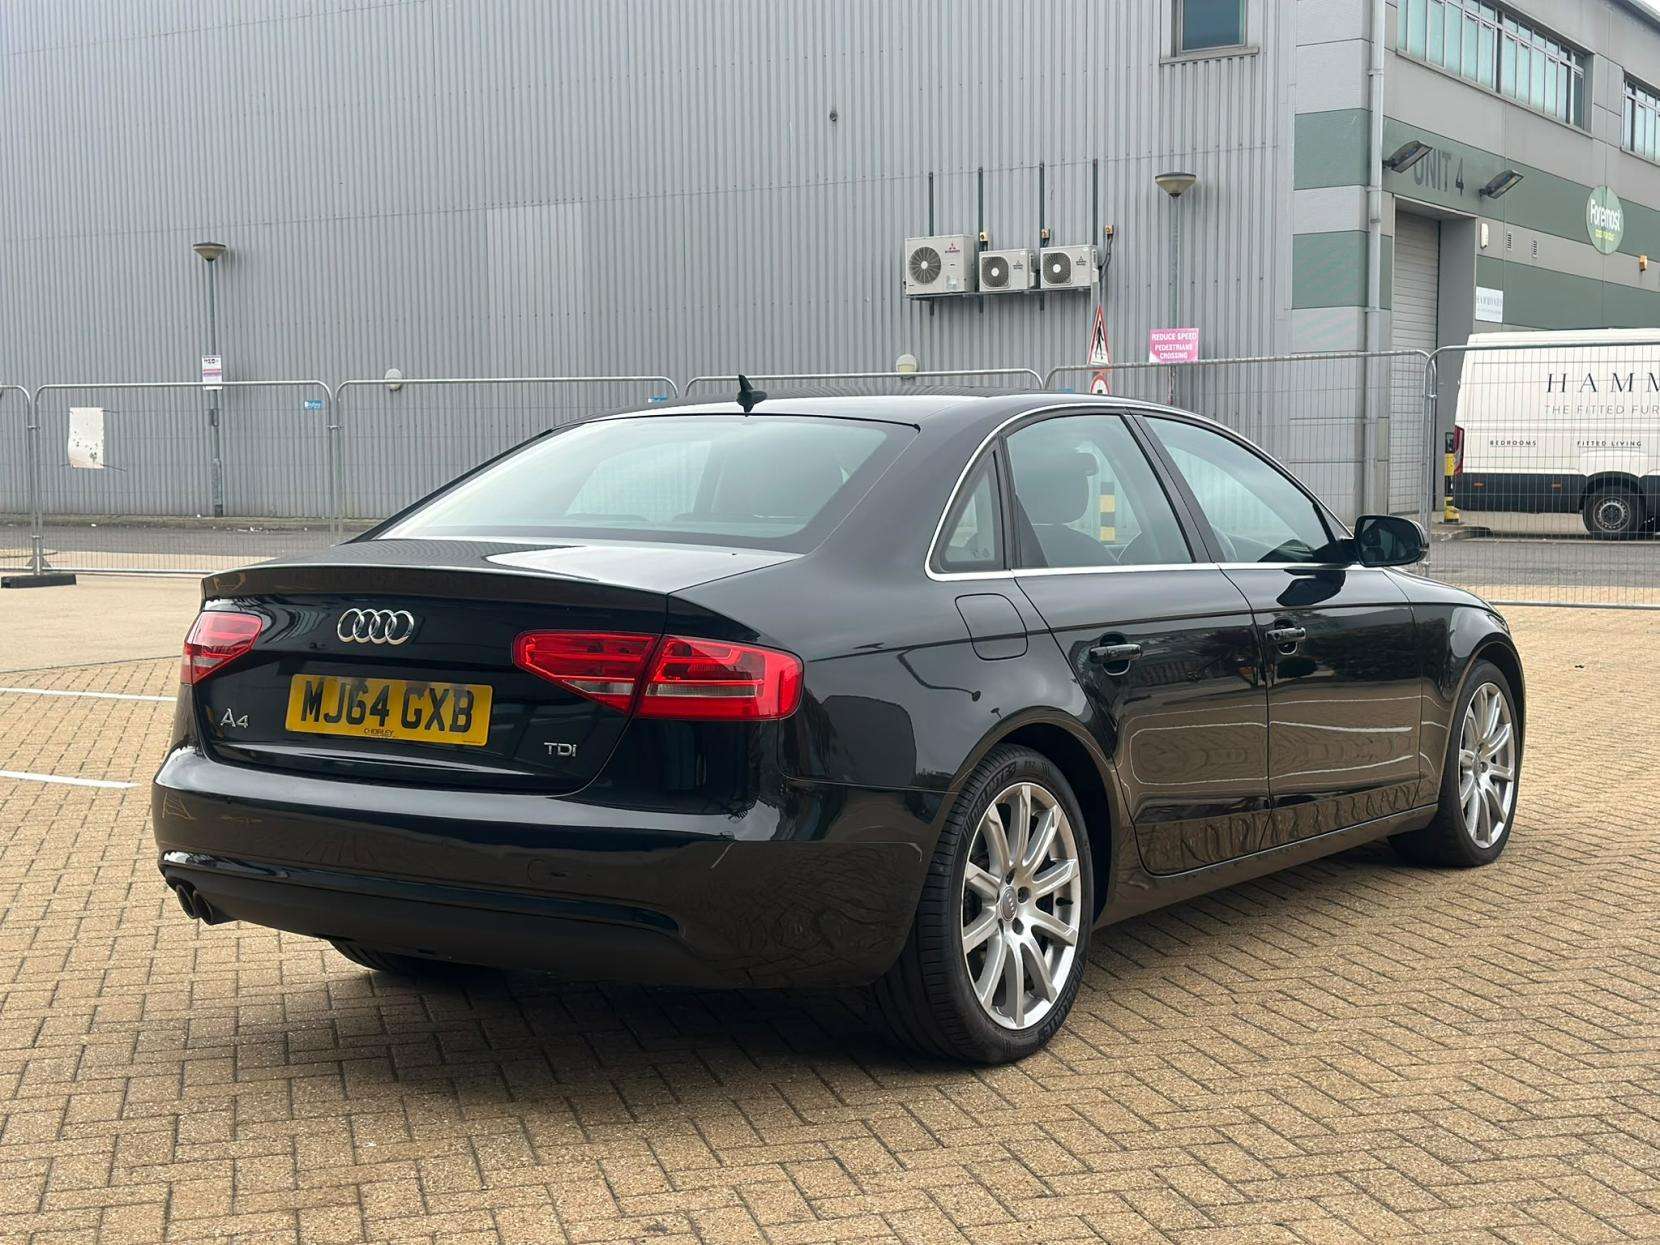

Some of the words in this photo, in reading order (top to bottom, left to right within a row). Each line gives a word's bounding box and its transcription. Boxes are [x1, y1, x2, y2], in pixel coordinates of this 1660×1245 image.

[1455, 157, 1465, 197] 4
[1151, 333, 1176, 341] REDUCE
[1177, 332, 1197, 340] SPEED
[1545, 404, 1569, 415] THE
[1577, 404, 1625, 415] FITTED
[301, 679, 389, 727] MJ64
[401, 687, 474, 733] GXB
[220, 707, 249, 729] A4
